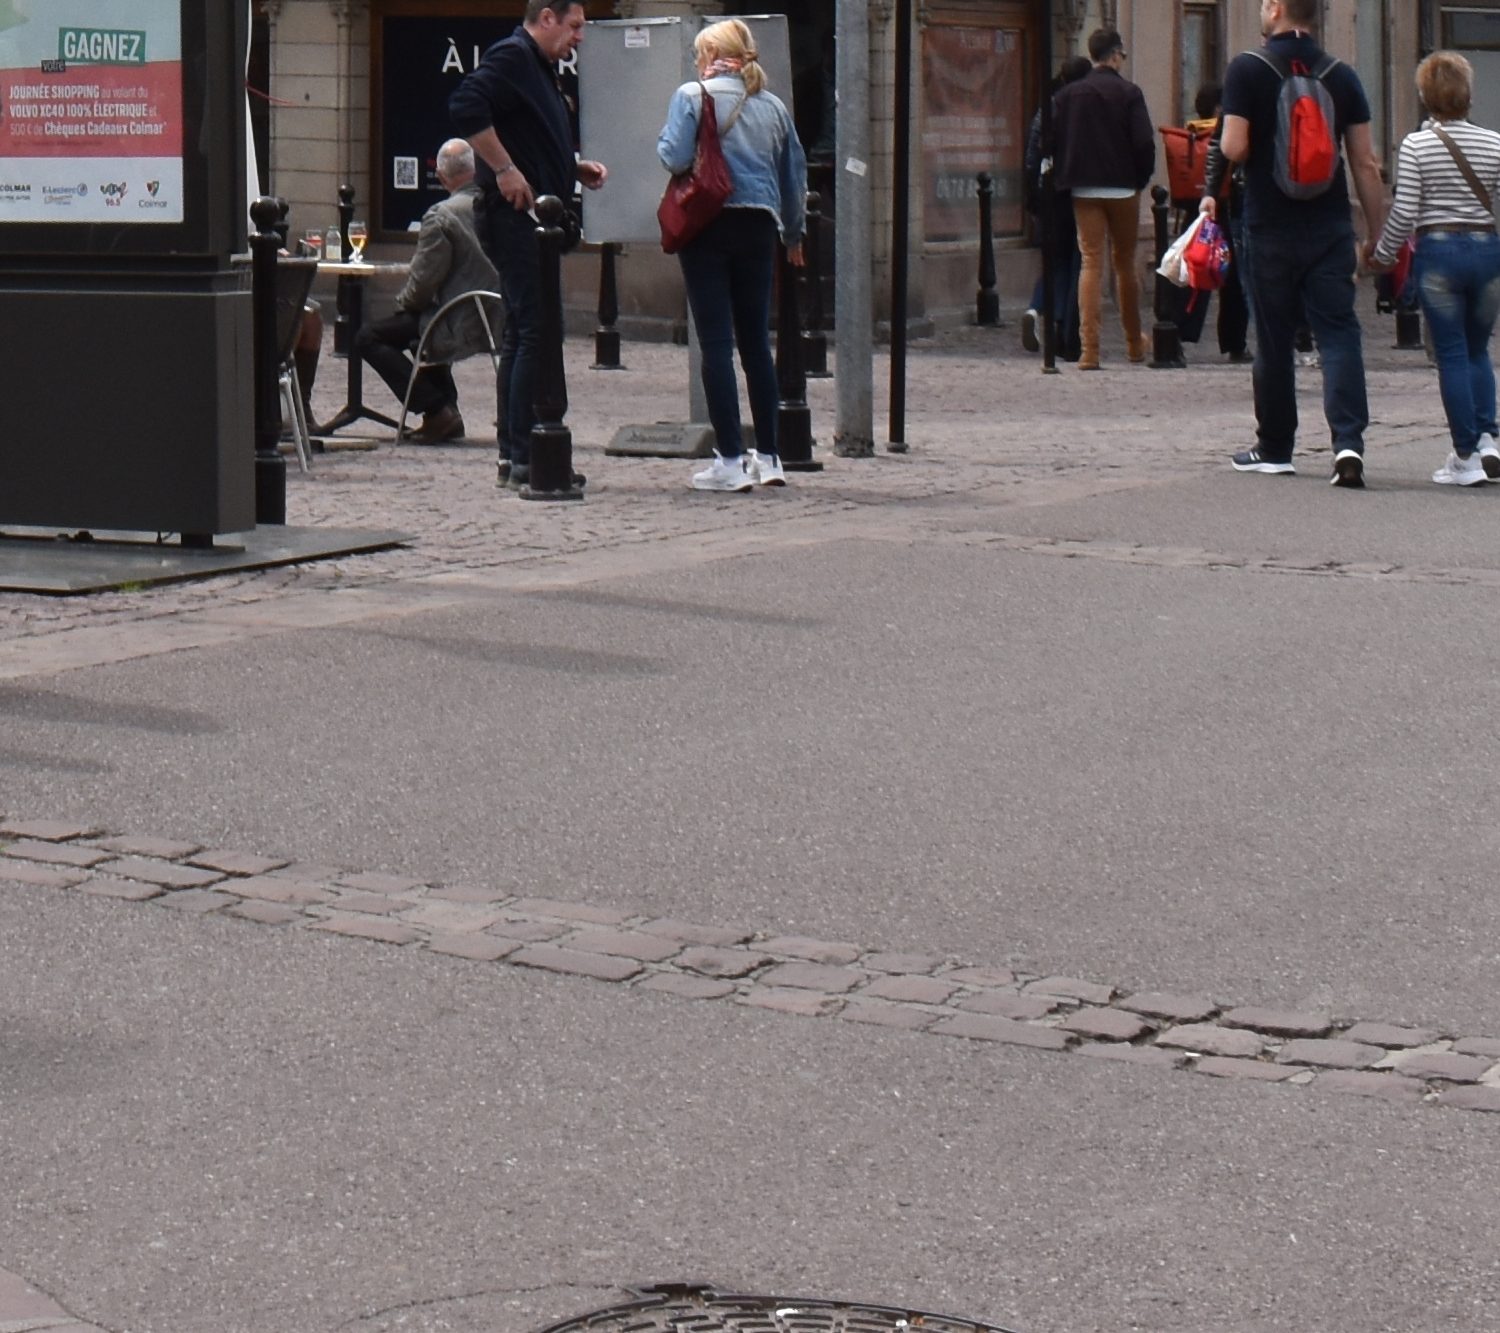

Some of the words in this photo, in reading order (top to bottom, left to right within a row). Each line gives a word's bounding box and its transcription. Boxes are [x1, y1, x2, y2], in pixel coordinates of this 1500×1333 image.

[64, 31, 140, 61] GAGNEZ
[441, 37, 465, 74] À
[42, 60, 65, 72] votre
[9, 82, 49, 100] JOURNÉE
[52, 84, 100, 100] SHOPPING
[9, 104, 38, 118] VOLVO
[40, 104, 64, 118] XC40
[67, 103, 92, 118] 100%
[93, 100, 148, 119] ÉLECTRIQUE
[44, 121, 86, 138] Chèques
[87, 121, 128, 135] Cadeaux
[0, 184, 31, 192] COLMAR
